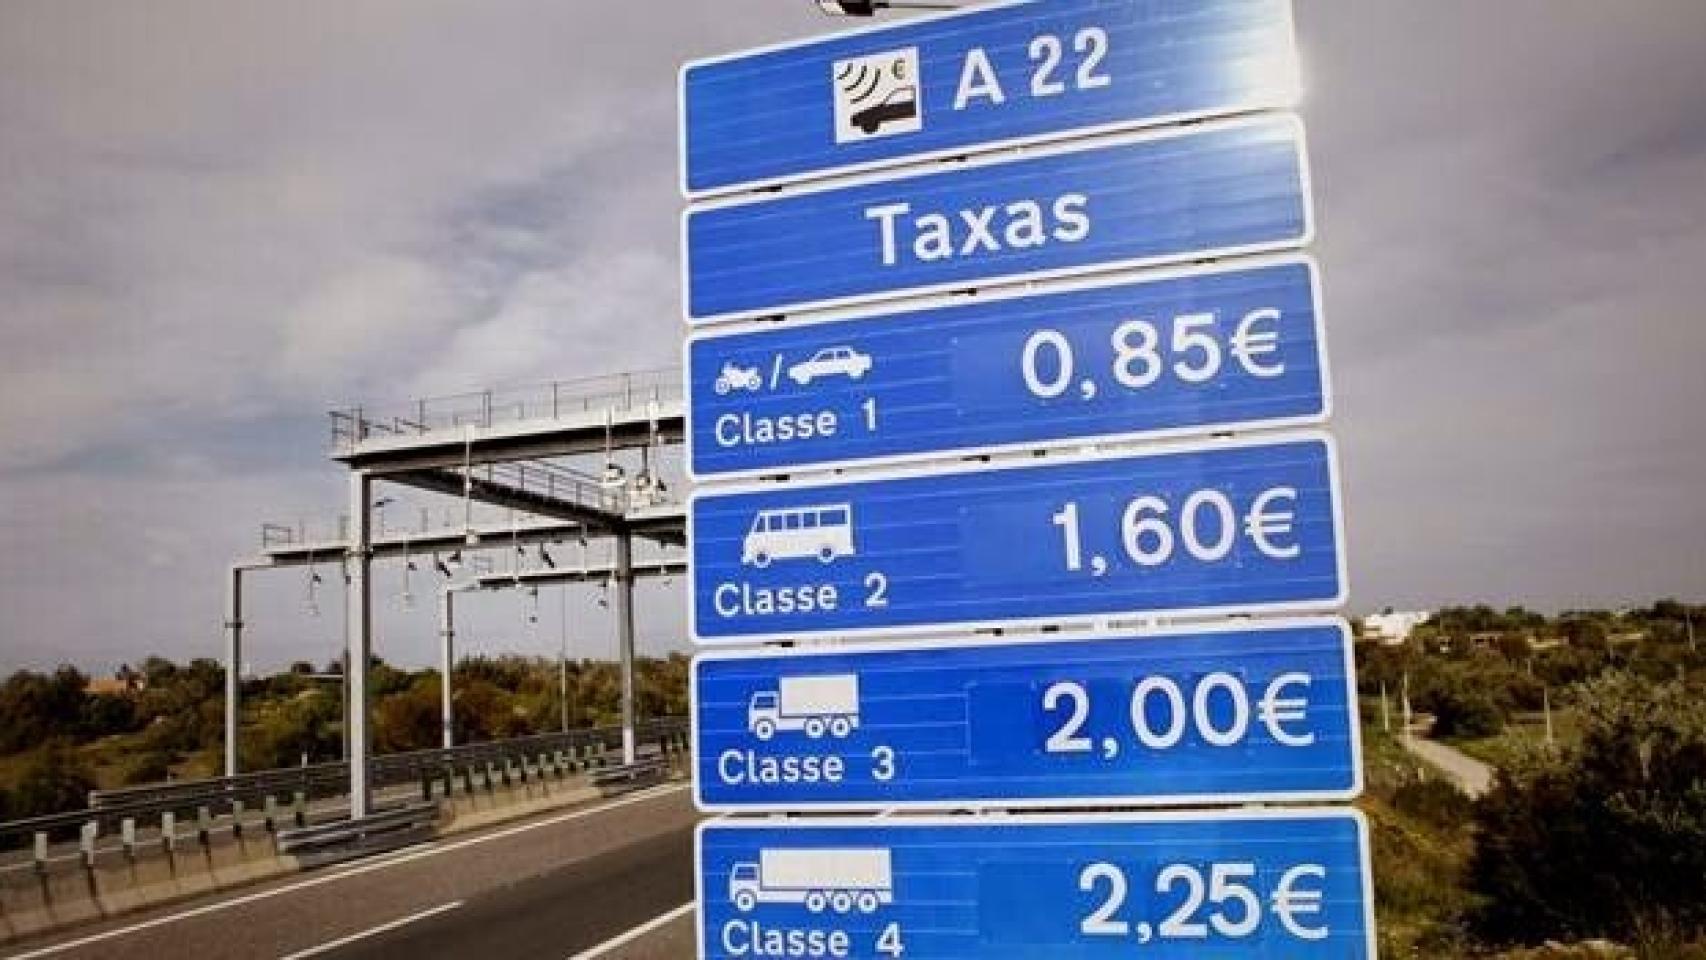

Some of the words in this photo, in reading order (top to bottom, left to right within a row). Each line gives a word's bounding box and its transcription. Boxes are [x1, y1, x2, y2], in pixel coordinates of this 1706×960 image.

[954, 48, 1005, 111] A
[1028, 26, 1112, 97] 22
[865, 192, 1091, 265] Taxas
[1022, 306, 1285, 399] 0,85€
[715, 411, 837, 446] Classe
[863, 399, 876, 430] 1
[1052, 487, 1299, 577] 1,60€
[715, 583, 837, 618] Classe
[865, 572, 887, 607] 2
[1044, 671, 1314, 758] 2,00€
[719, 750, 843, 783] Classe
[872, 745, 895, 780] 3
[723, 920, 849, 956] Classe
[877, 923, 903, 958] 4
[1080, 863, 1328, 942] 2,25€
